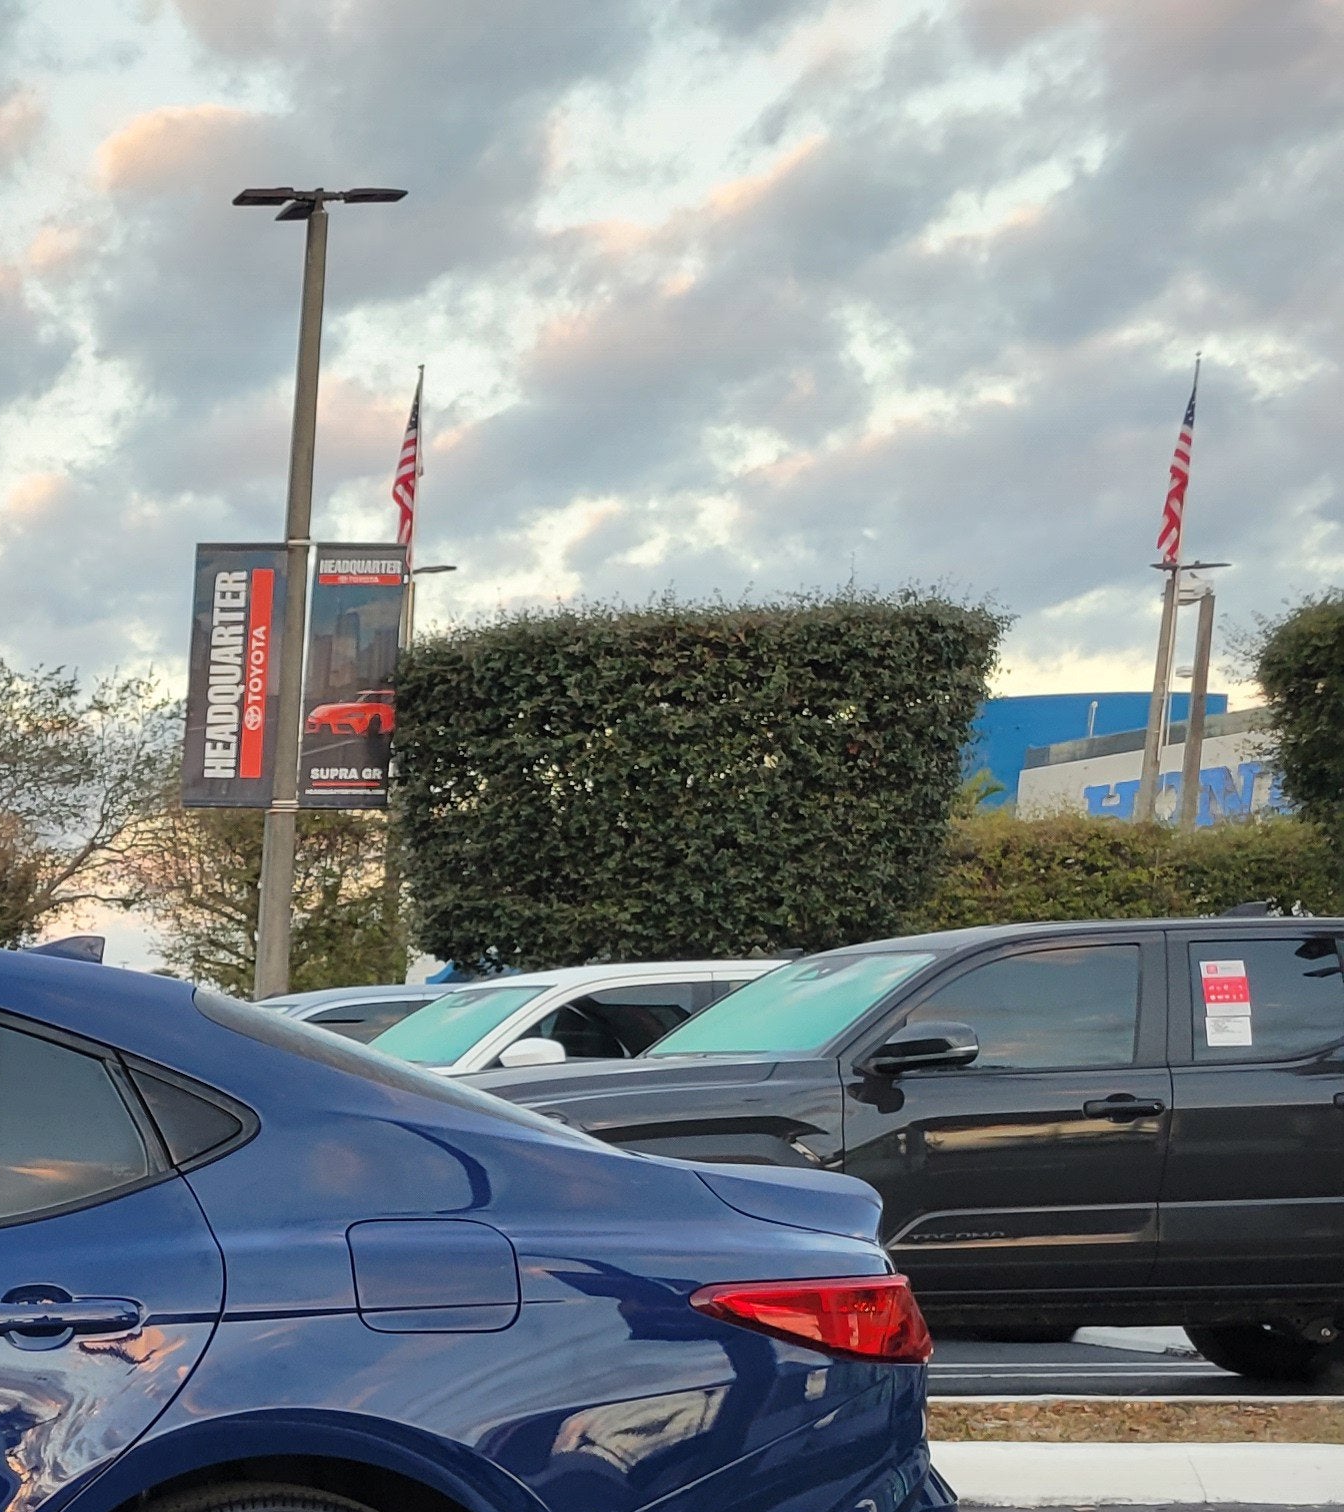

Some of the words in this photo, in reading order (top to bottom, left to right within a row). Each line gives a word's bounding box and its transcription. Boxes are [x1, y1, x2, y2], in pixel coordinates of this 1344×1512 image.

[320, 560, 402, 575] HEADQUARTER
[204, 571, 247, 778] HEADQUARTER
[247, 626, 267, 704] TOYOTA
[310, 767, 359, 780] SUPRA
[362, 767, 383, 780] GR
